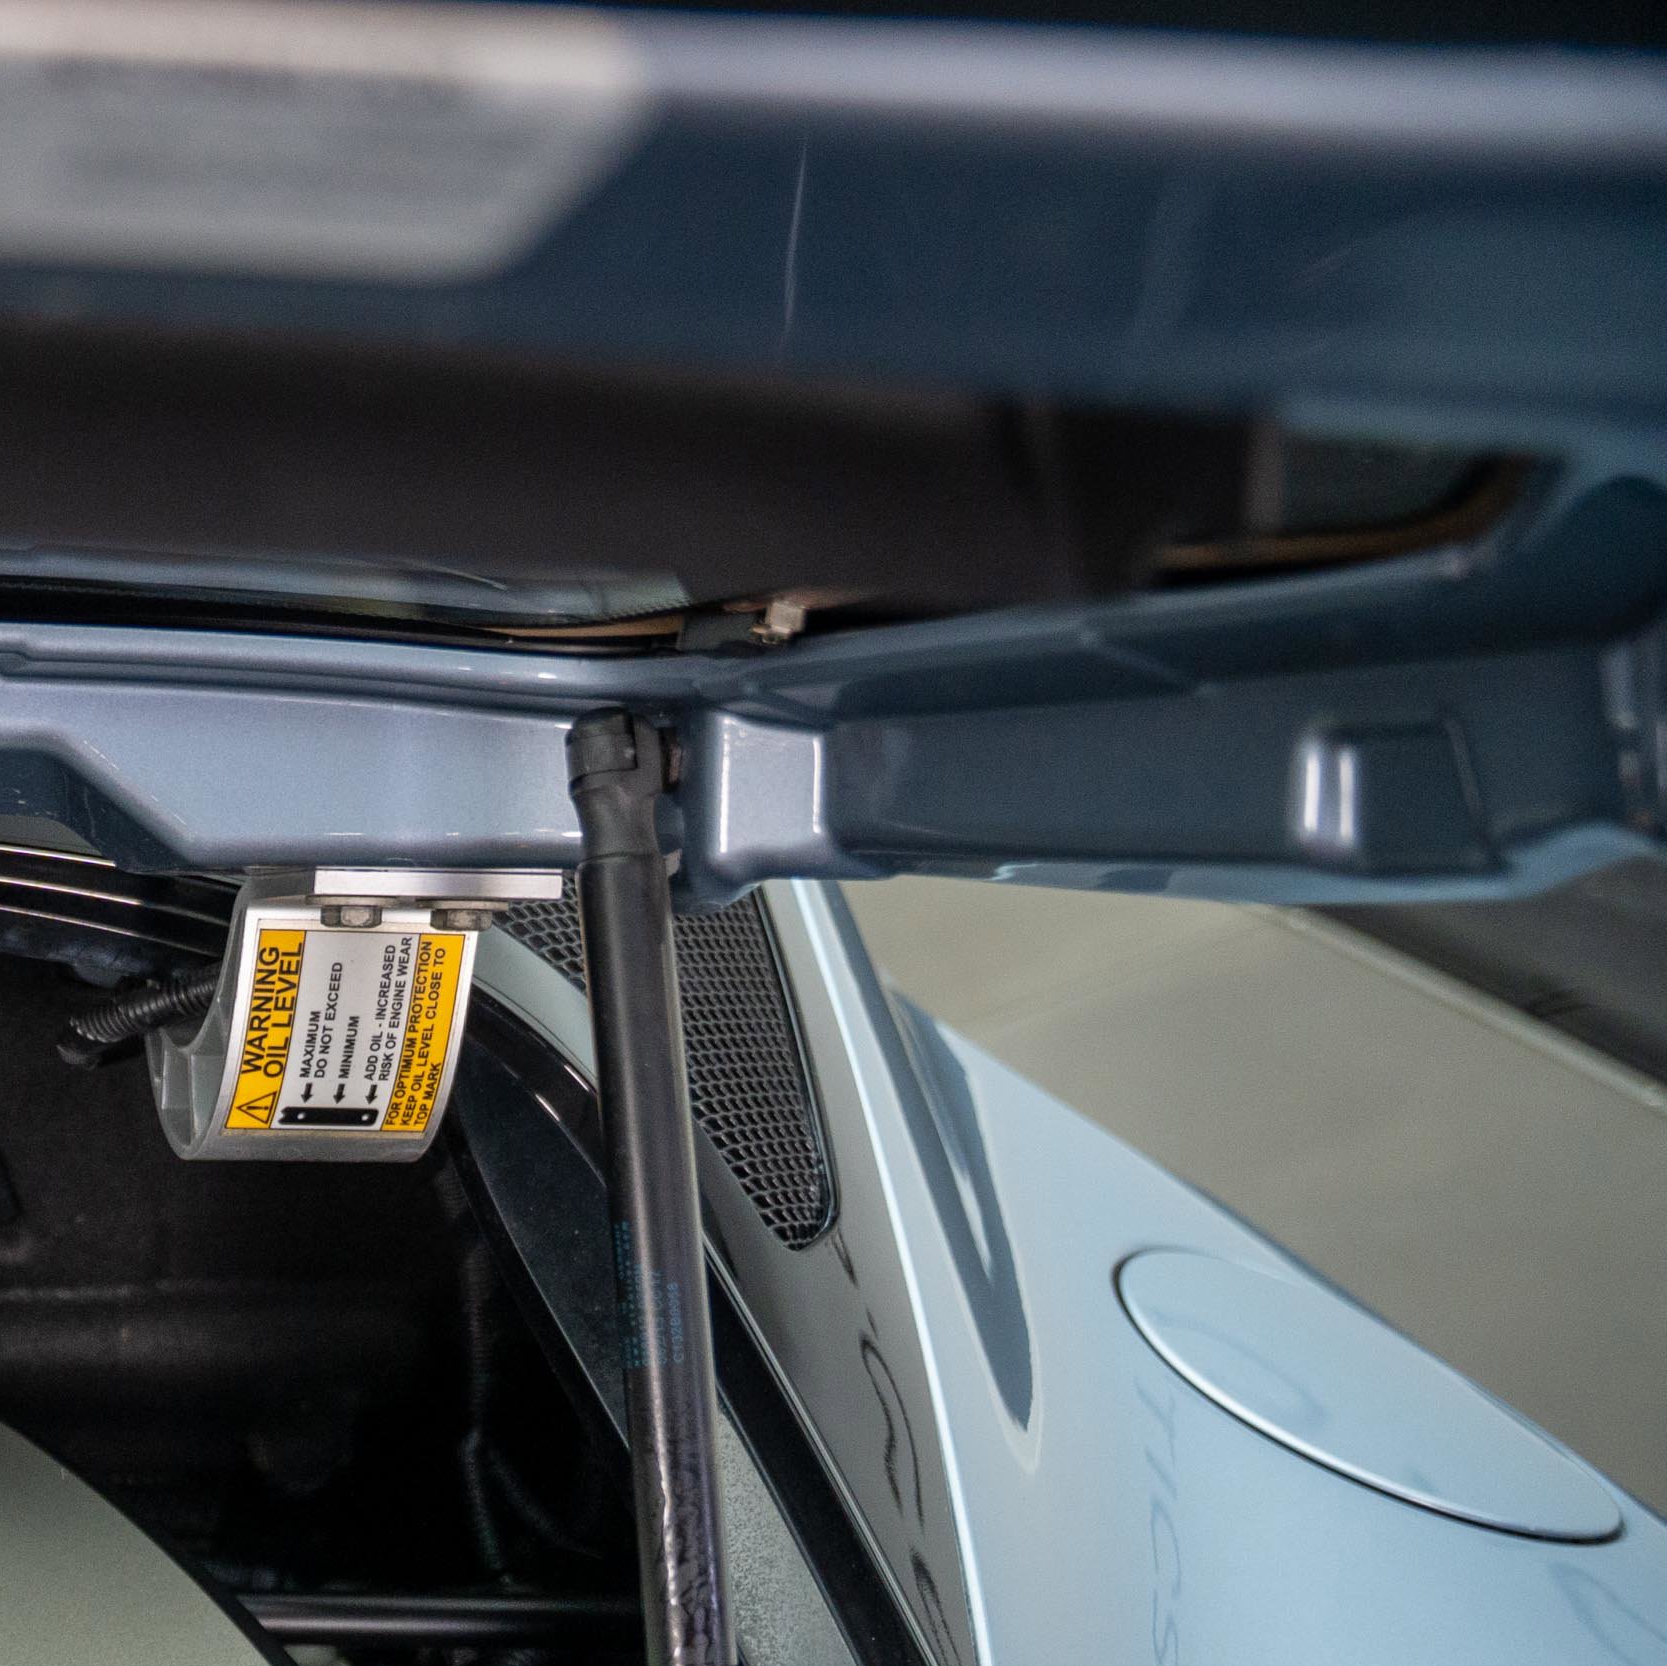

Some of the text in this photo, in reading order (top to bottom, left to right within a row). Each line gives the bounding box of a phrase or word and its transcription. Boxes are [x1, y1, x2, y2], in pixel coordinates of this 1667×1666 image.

[241, 947, 279, 1074] WARNING
[263, 942, 302, 1078] OIL LEVEL
[314, 962, 342, 1078] DO NOT EXCEED
[375, 945, 395, 1020] INCREASED
[379, 937, 412, 1081] RISK OF ENGINE WEAR
[299, 1011, 321, 1078] MAXIMUM
[339, 1016, 359, 1079] MINIMUM
[364, 1056, 378, 1080] ADD
[370, 1031, 382, 1052] OIL
[386, 942, 432, 1125] FOR OPTIMUM PROTECTION
[400, 948, 446, 1126] KEEP OIL LEVEL CLOSE TO
[415, 1063, 441, 1126] TOP MARK
